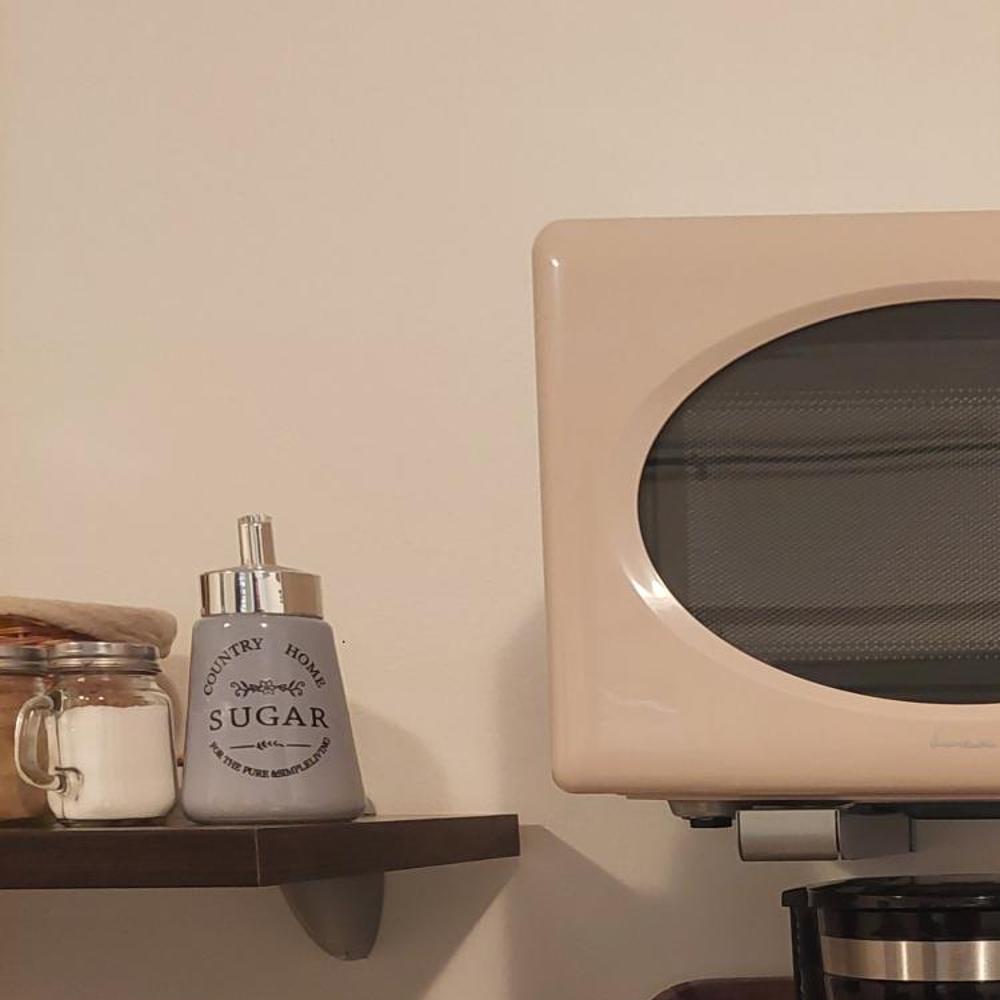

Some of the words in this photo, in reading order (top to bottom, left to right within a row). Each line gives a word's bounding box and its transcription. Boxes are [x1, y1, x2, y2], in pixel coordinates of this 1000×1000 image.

[203, 637, 264, 697] COUNTRY
[285, 643, 327, 689] HOME
[208, 705, 330, 731] SUGAR
[223, 754, 243, 773] THE
[242, 765, 270, 779] PURE
